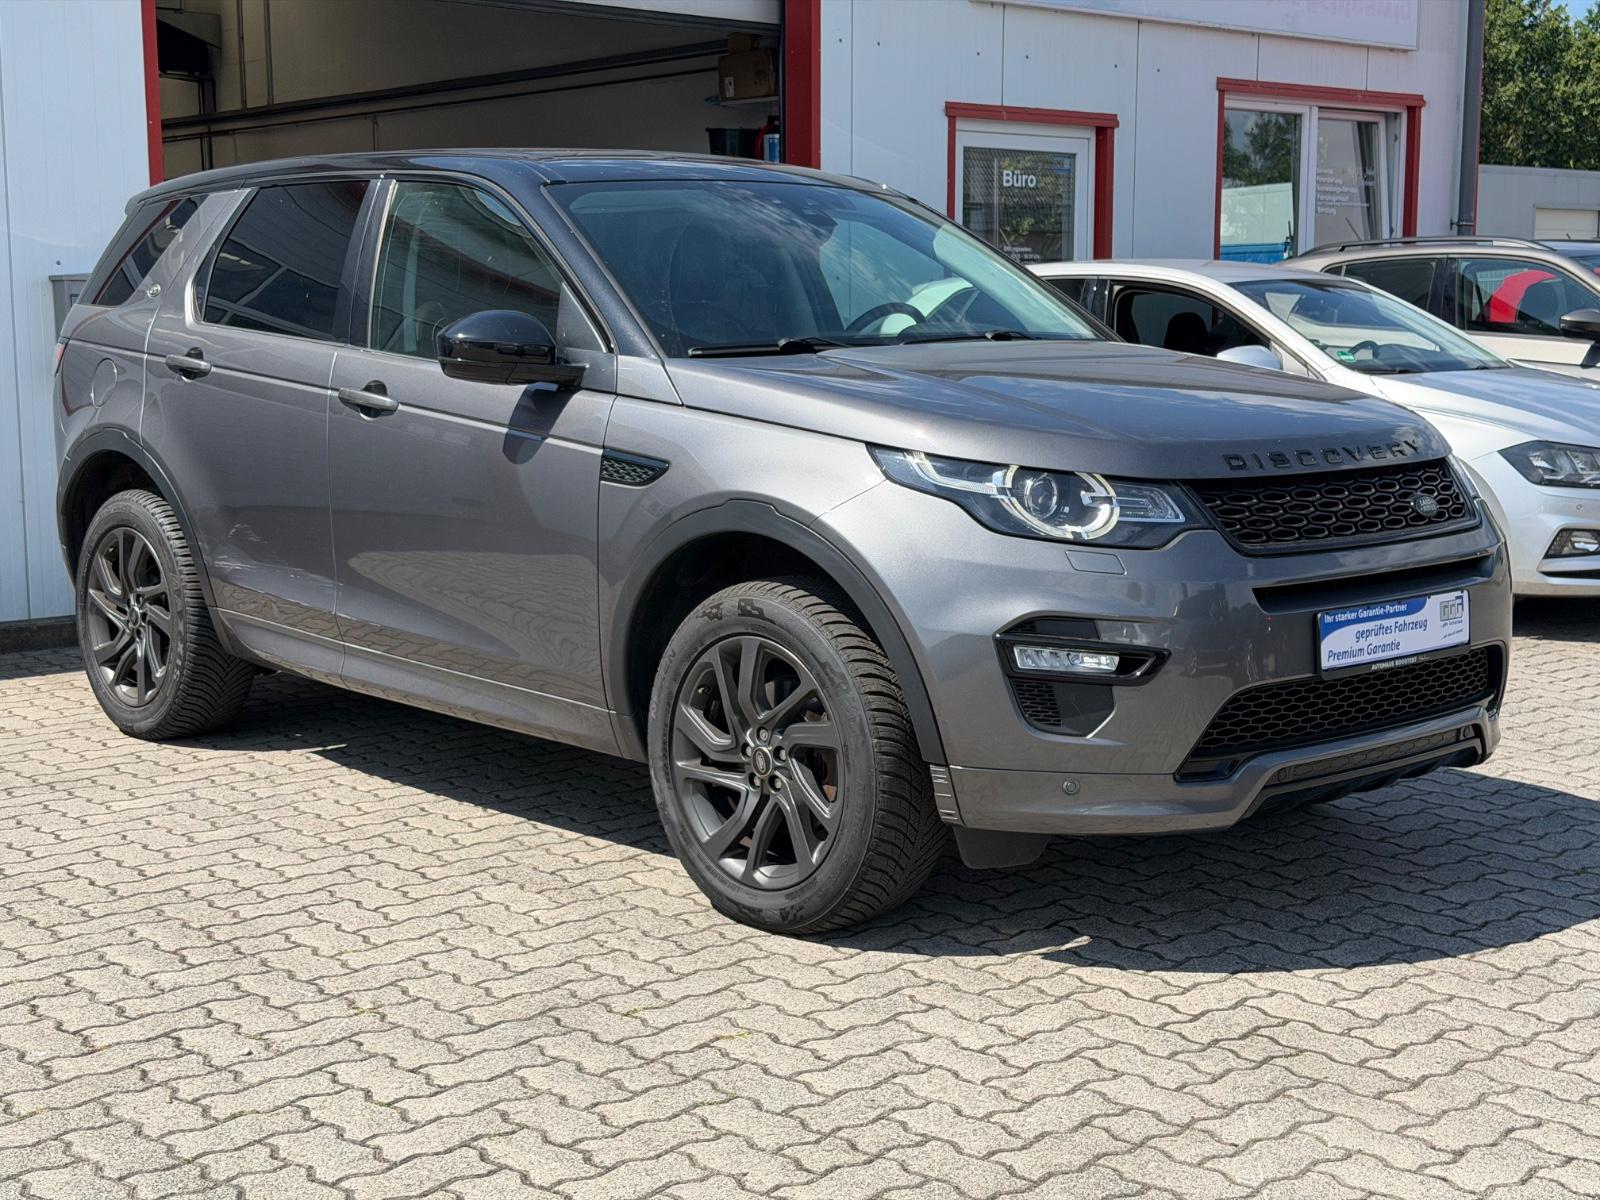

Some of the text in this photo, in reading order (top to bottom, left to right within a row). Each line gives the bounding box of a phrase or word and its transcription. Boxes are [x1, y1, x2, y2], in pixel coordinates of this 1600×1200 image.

[1003, 170, 1036, 188] Büro
[1223, 439, 1419, 471] DISCOVERY
[1324, 604, 1408, 624] Ihr starker Garantie-Partner
[1355, 621, 1393, 643] geprüftes
[1394, 618, 1428, 635] Fahrzeug
[1328, 641, 1401, 662] Premium Garantie
